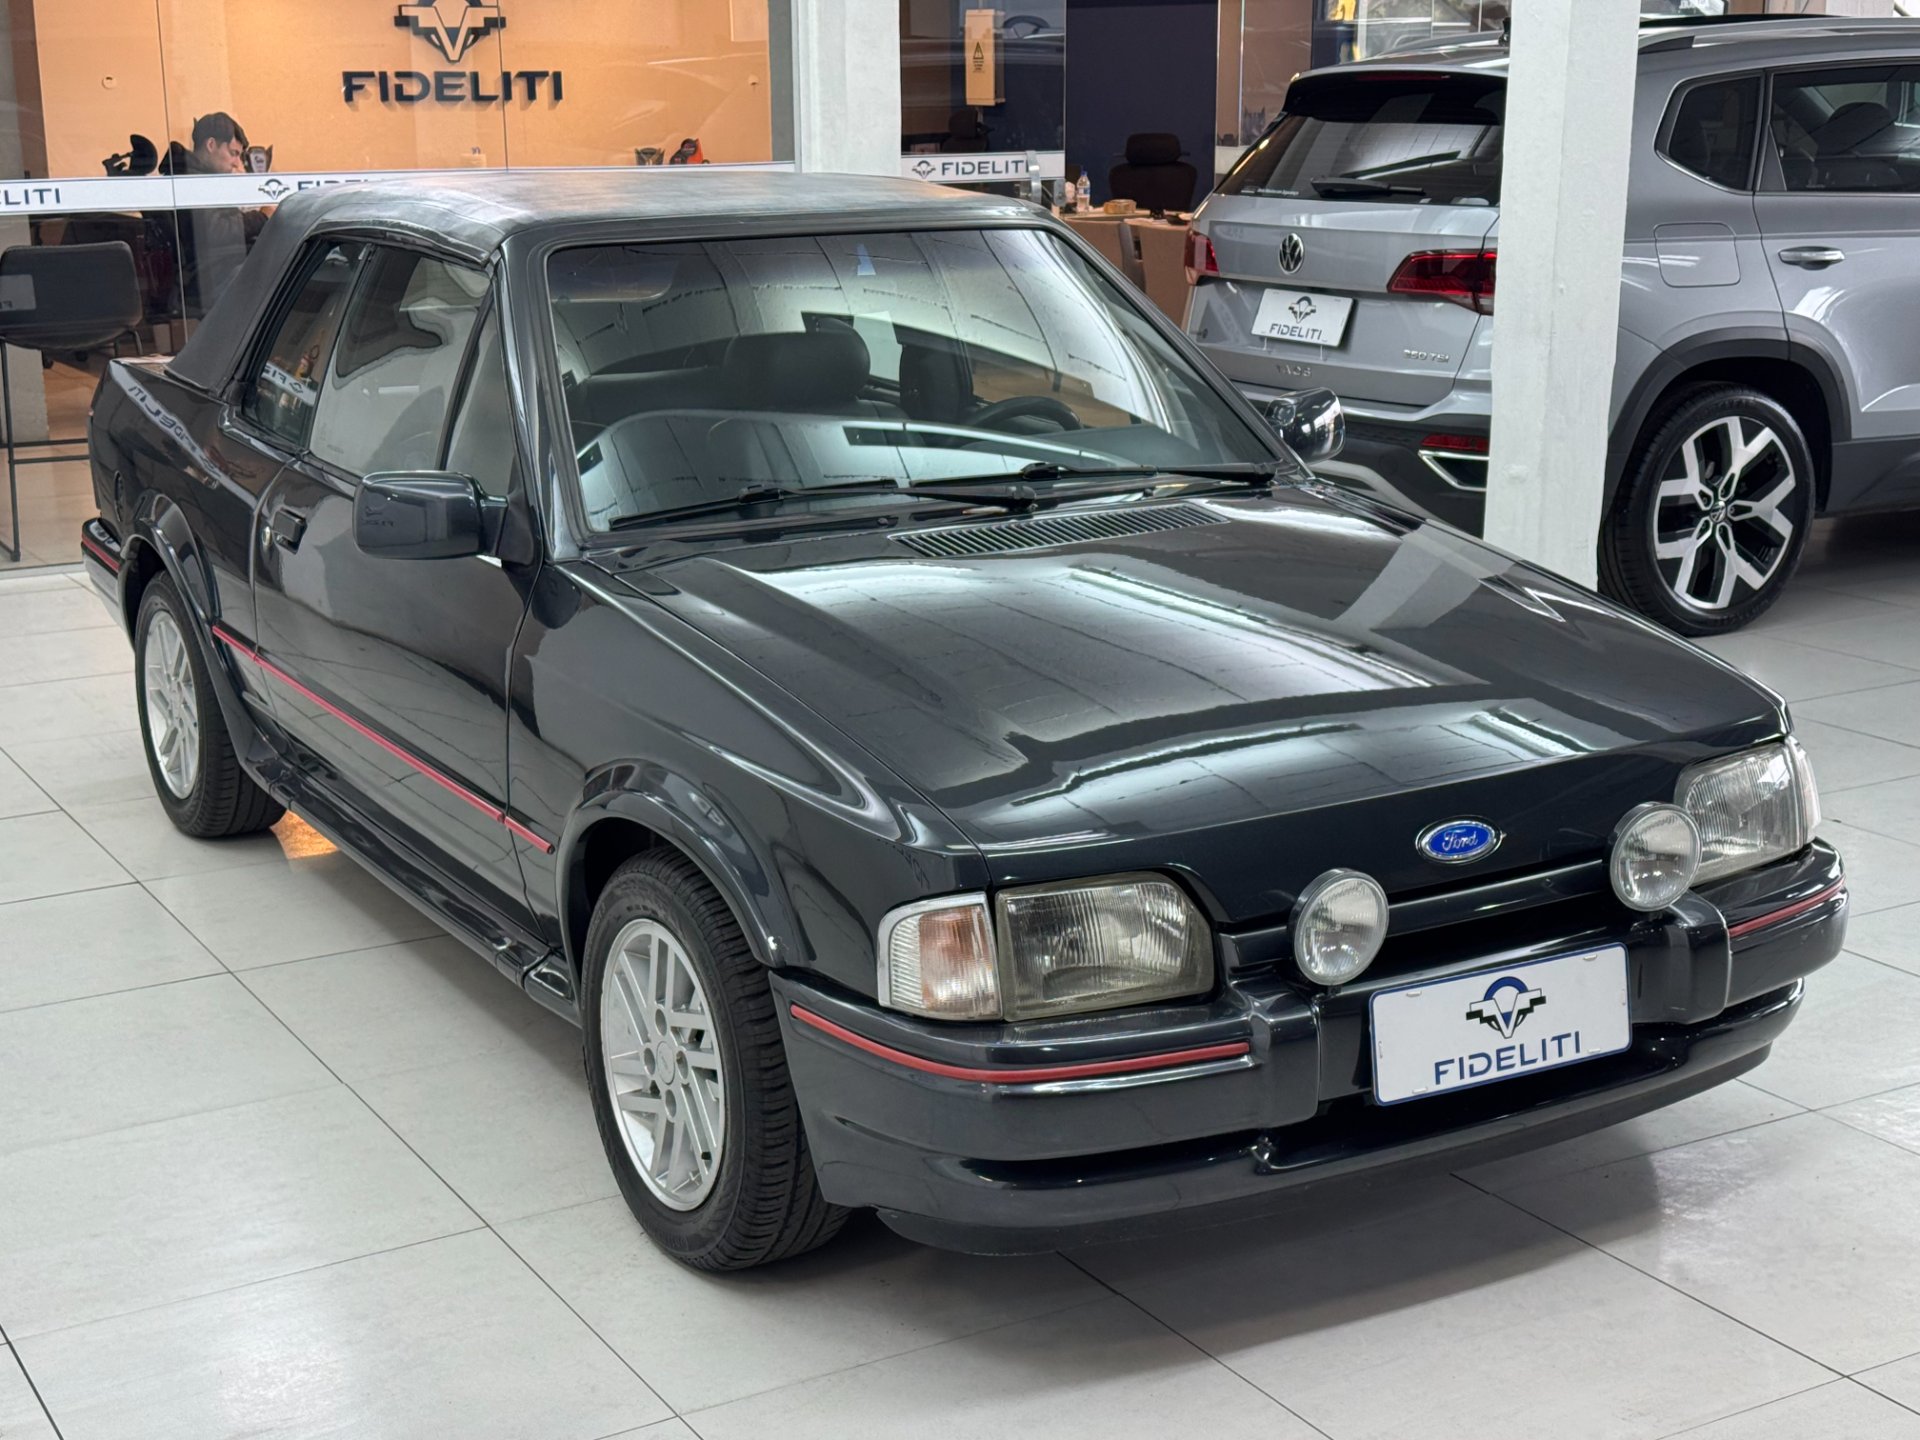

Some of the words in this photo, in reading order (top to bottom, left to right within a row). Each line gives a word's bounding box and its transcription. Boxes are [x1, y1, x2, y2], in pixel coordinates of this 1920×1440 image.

[342, 71, 563, 101] FIDELITI
[0, 188, 61, 205] LITI
[1269, 323, 1323, 340] FIDELITI
[1442, 828, 1478, 851] Ford
[1434, 1031, 1581, 1085] FIDELITI
